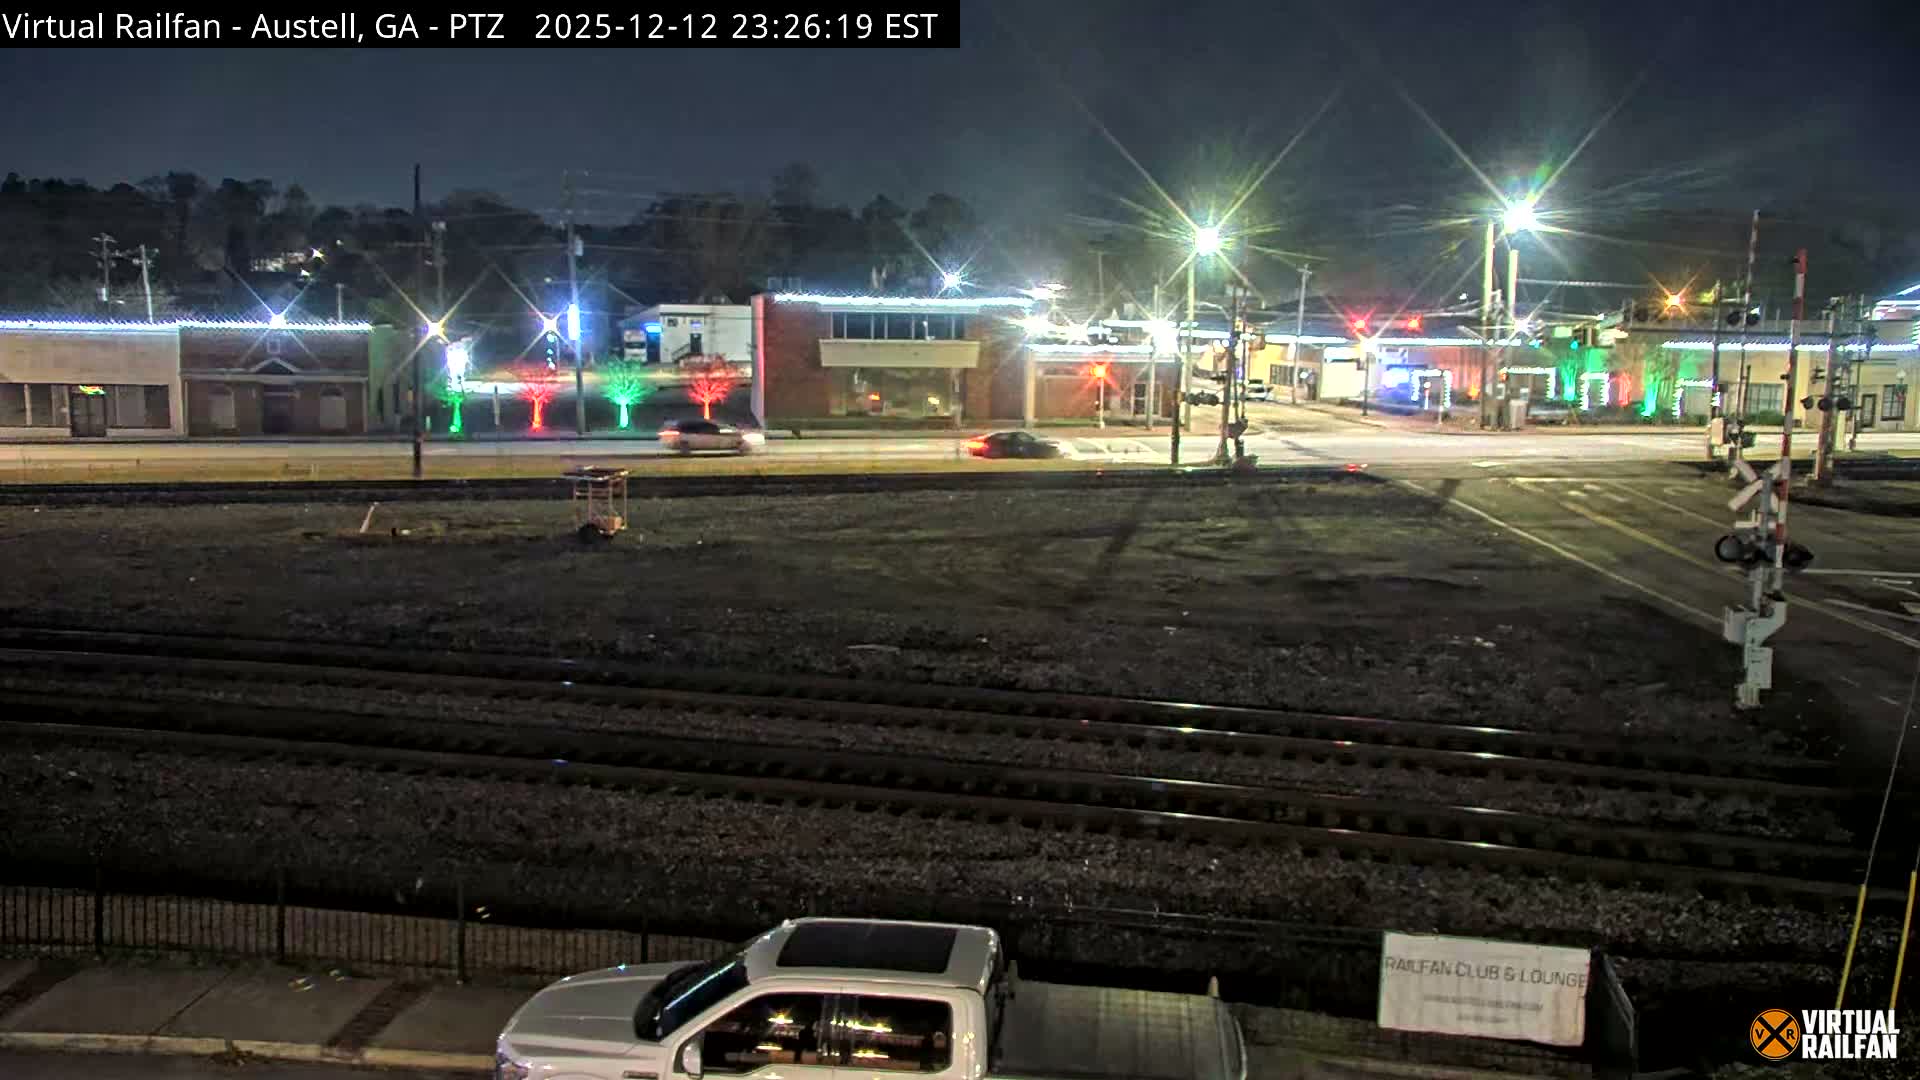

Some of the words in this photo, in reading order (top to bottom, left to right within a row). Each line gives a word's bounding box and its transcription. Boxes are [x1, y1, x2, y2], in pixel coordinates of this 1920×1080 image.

[1384, 956, 1450, 976] RAILFAN
[1455, 961, 1499, 981] CLUB
[1503, 966, 1515, 981] &
[1520, 968, 1589, 989] LOUNGE
